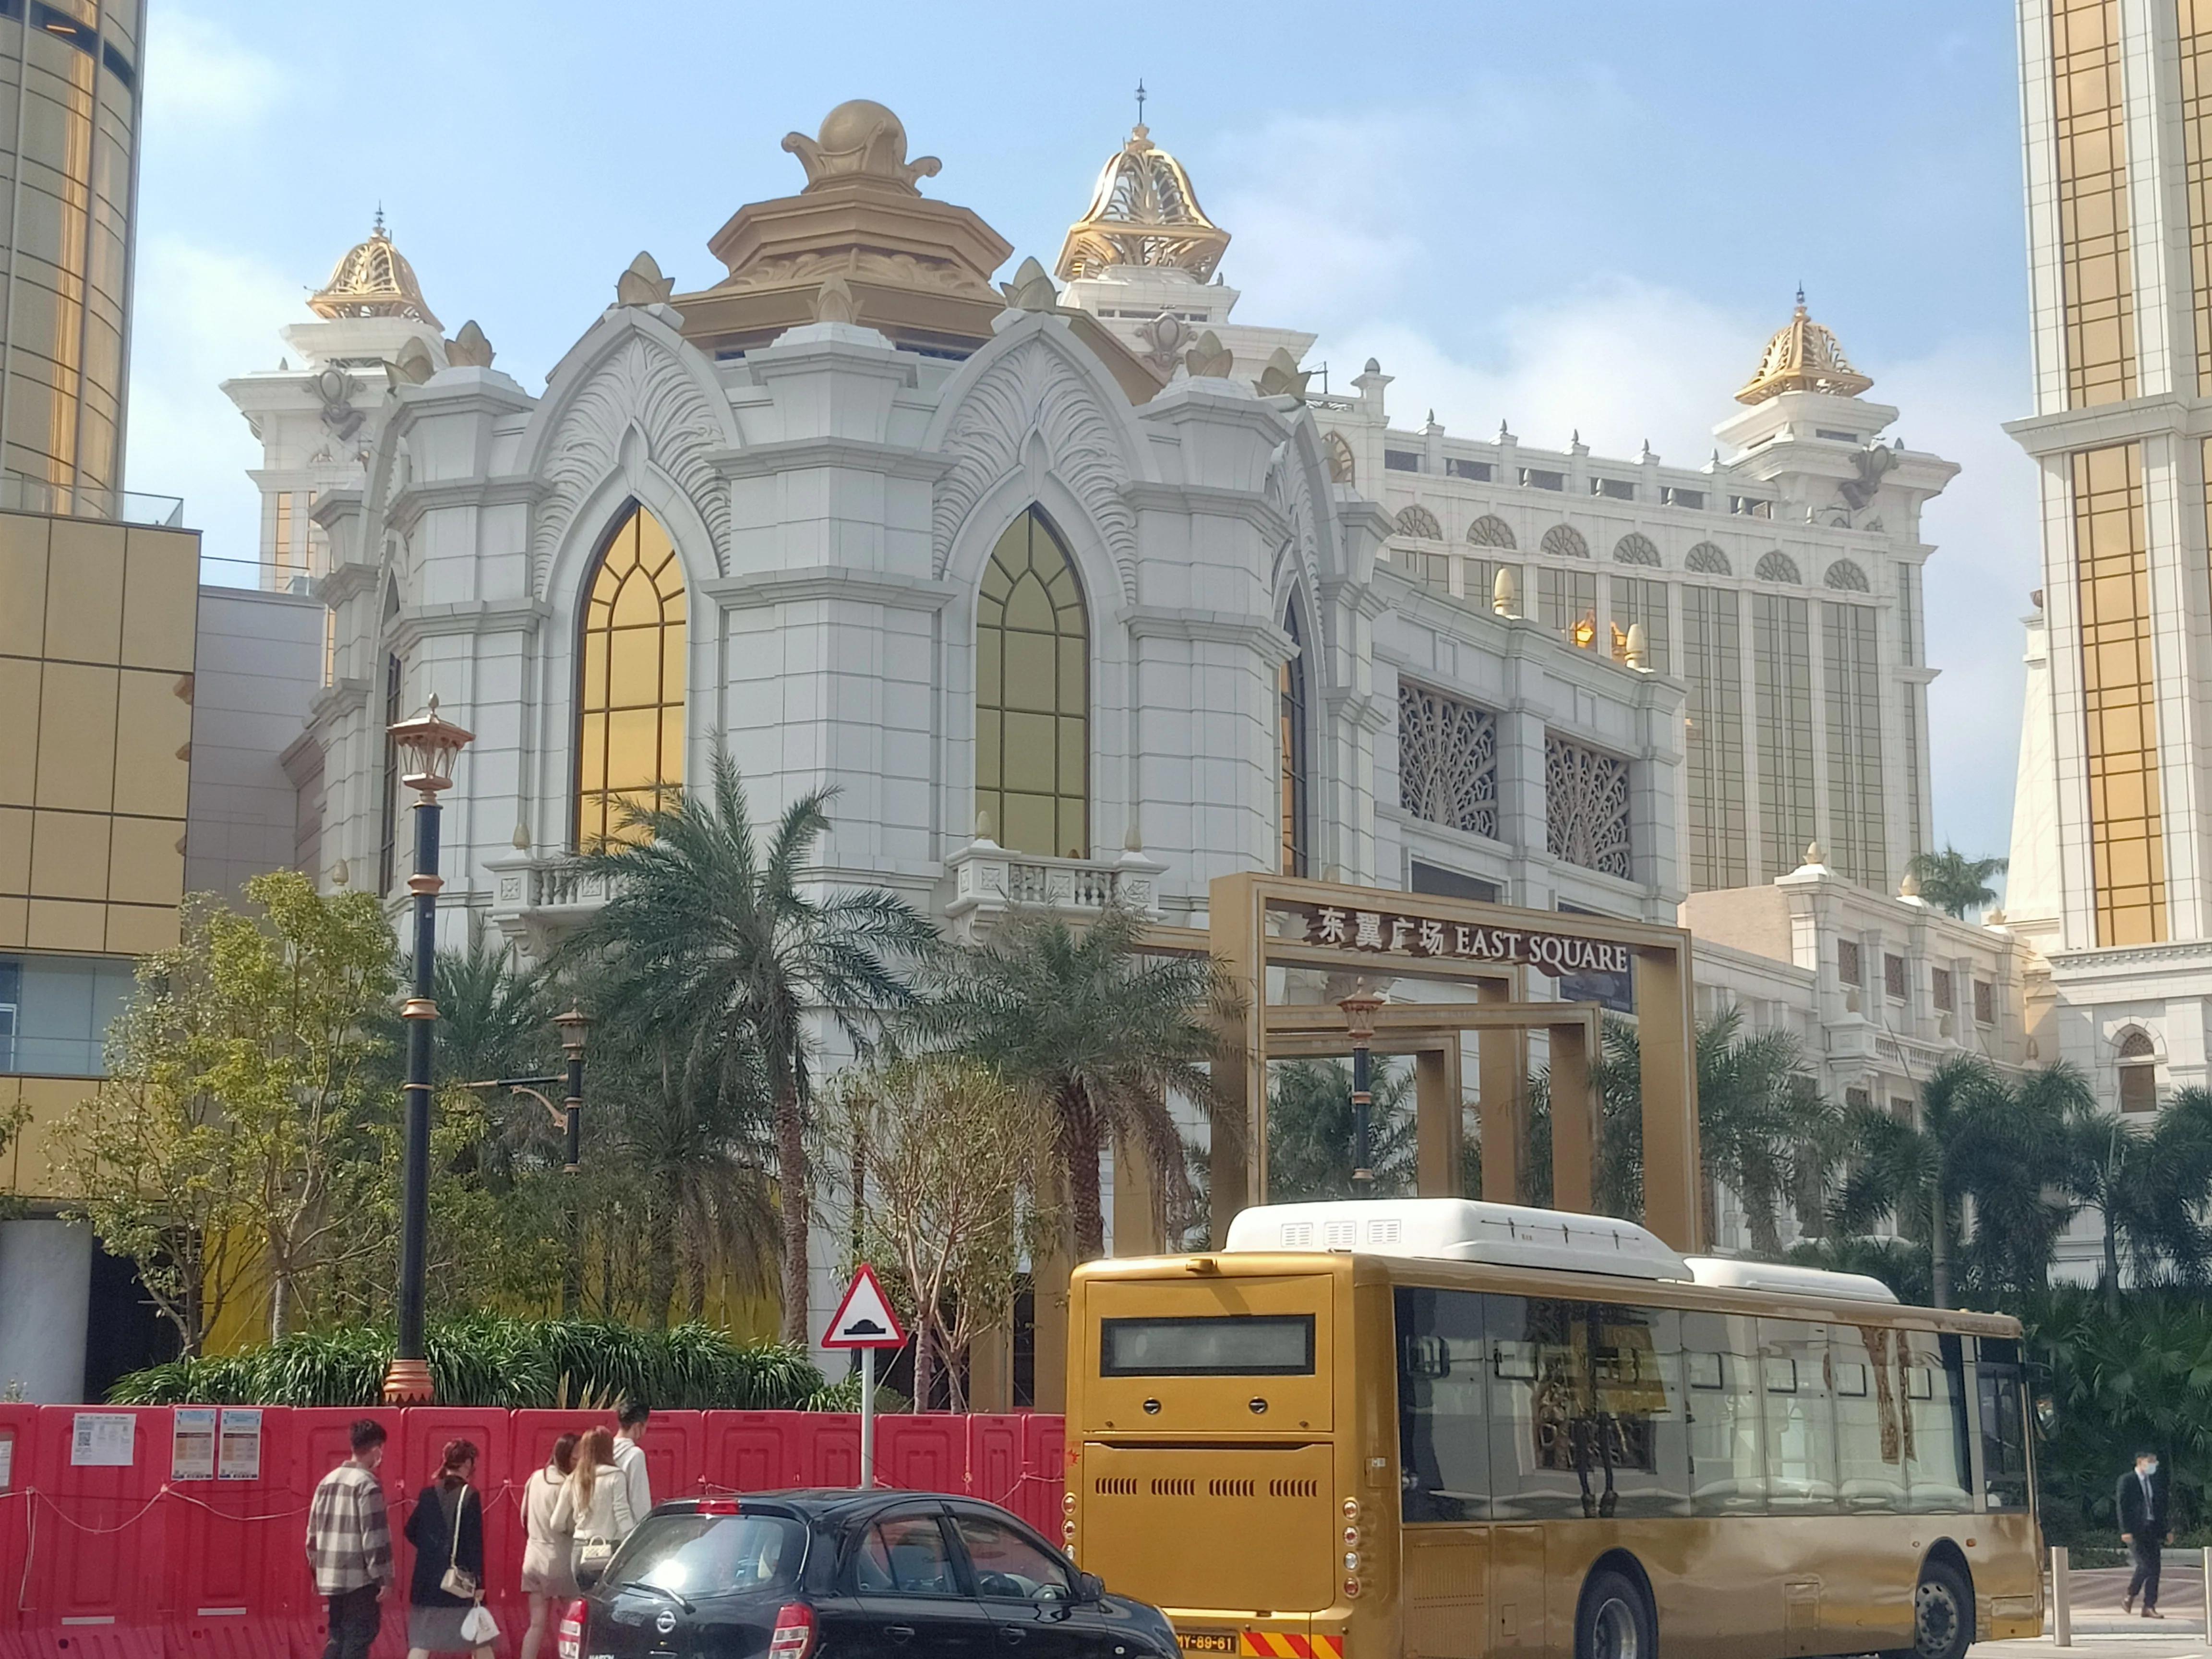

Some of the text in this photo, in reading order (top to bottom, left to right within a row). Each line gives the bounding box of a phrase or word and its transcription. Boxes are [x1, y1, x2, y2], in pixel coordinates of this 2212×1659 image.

[1319, 907, 1627, 975] 东翼广场 EAST SQUARE
